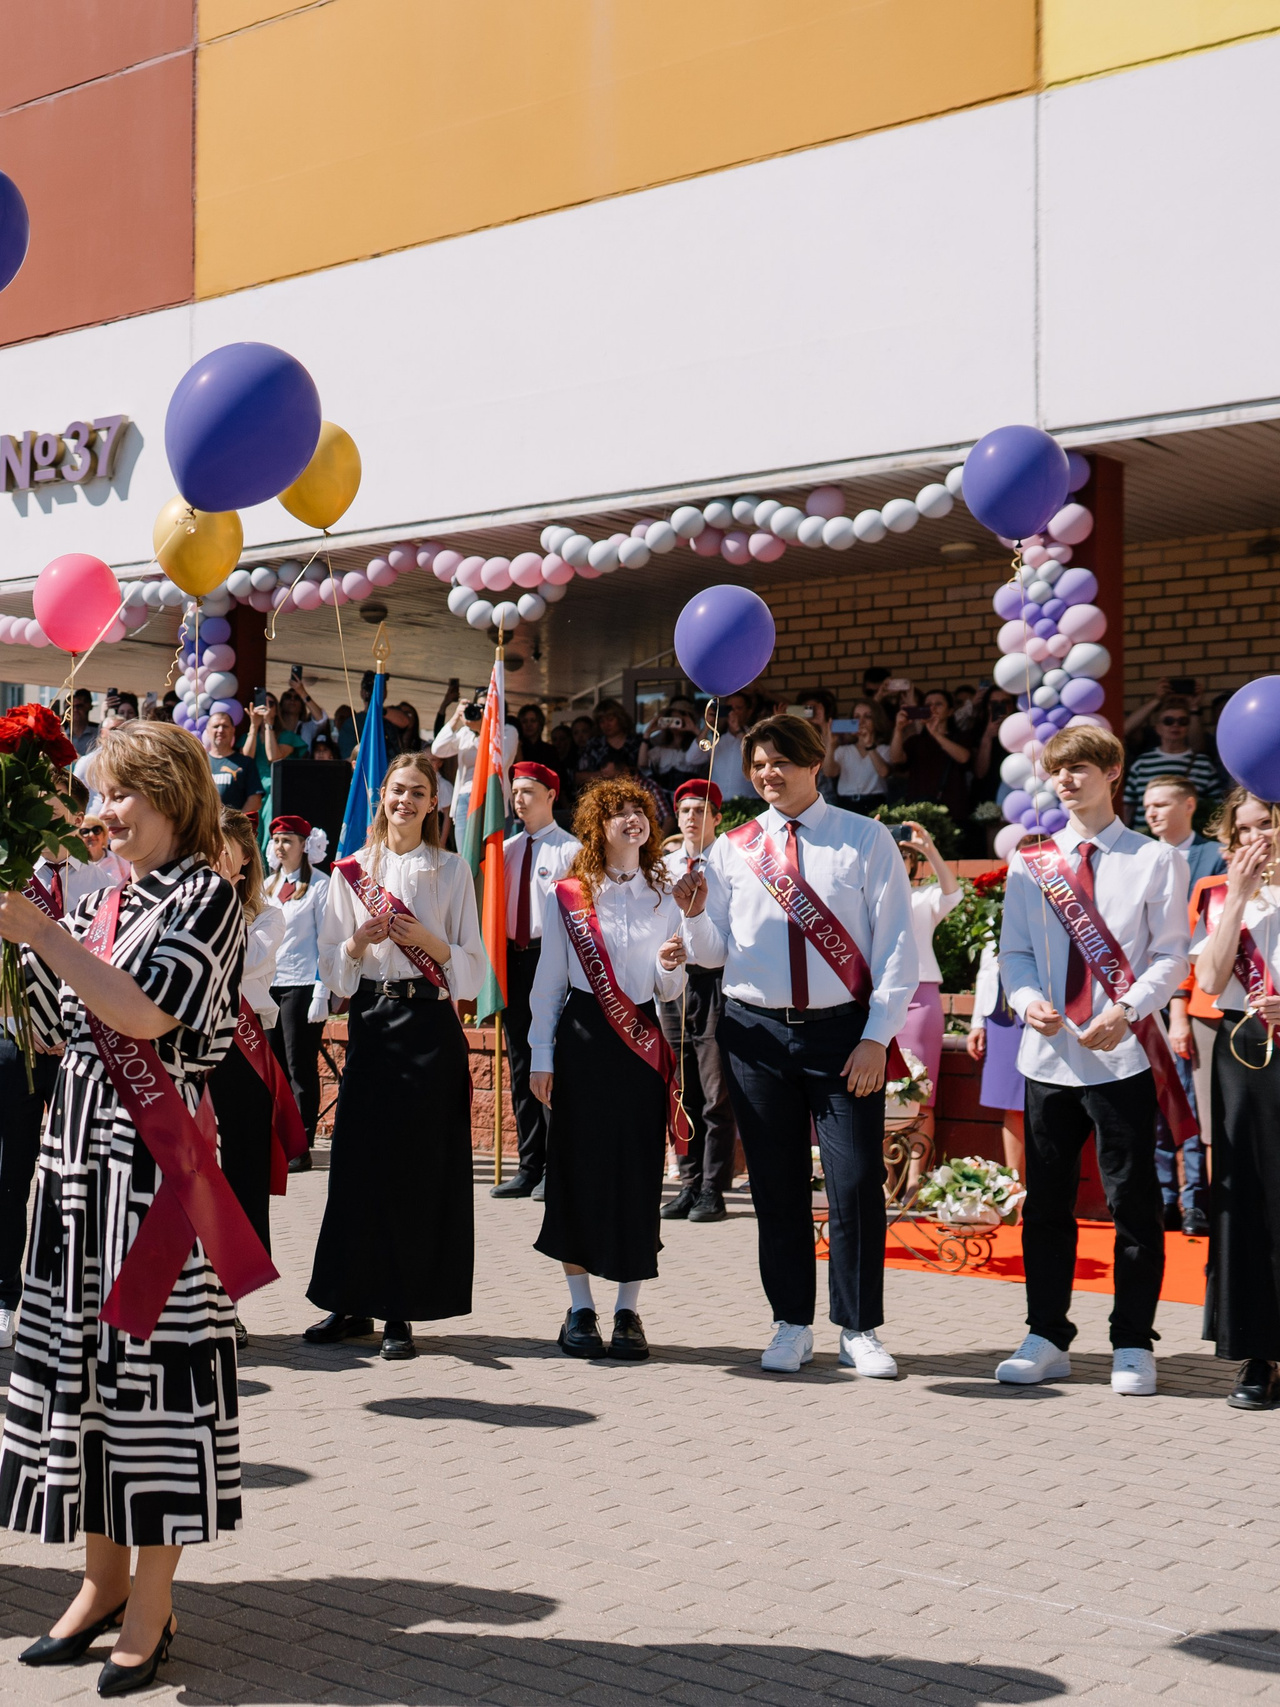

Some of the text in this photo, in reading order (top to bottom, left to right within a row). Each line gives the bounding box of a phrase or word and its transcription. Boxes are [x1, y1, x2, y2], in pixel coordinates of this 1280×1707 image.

[0, 414, 130, 493] №37
[743, 832, 852, 966] ВЫПУСКНИК 2024
[1034, 849, 1130, 995] ВЫПУСКНИК 202
[569, 908, 656, 1052] ВЫПУСКНИЦА 2024
[99, 1038, 115, 1070] МИНСКА
[237, 1013, 260, 1051] 2024
[114, 1042, 164, 1108] 2024
